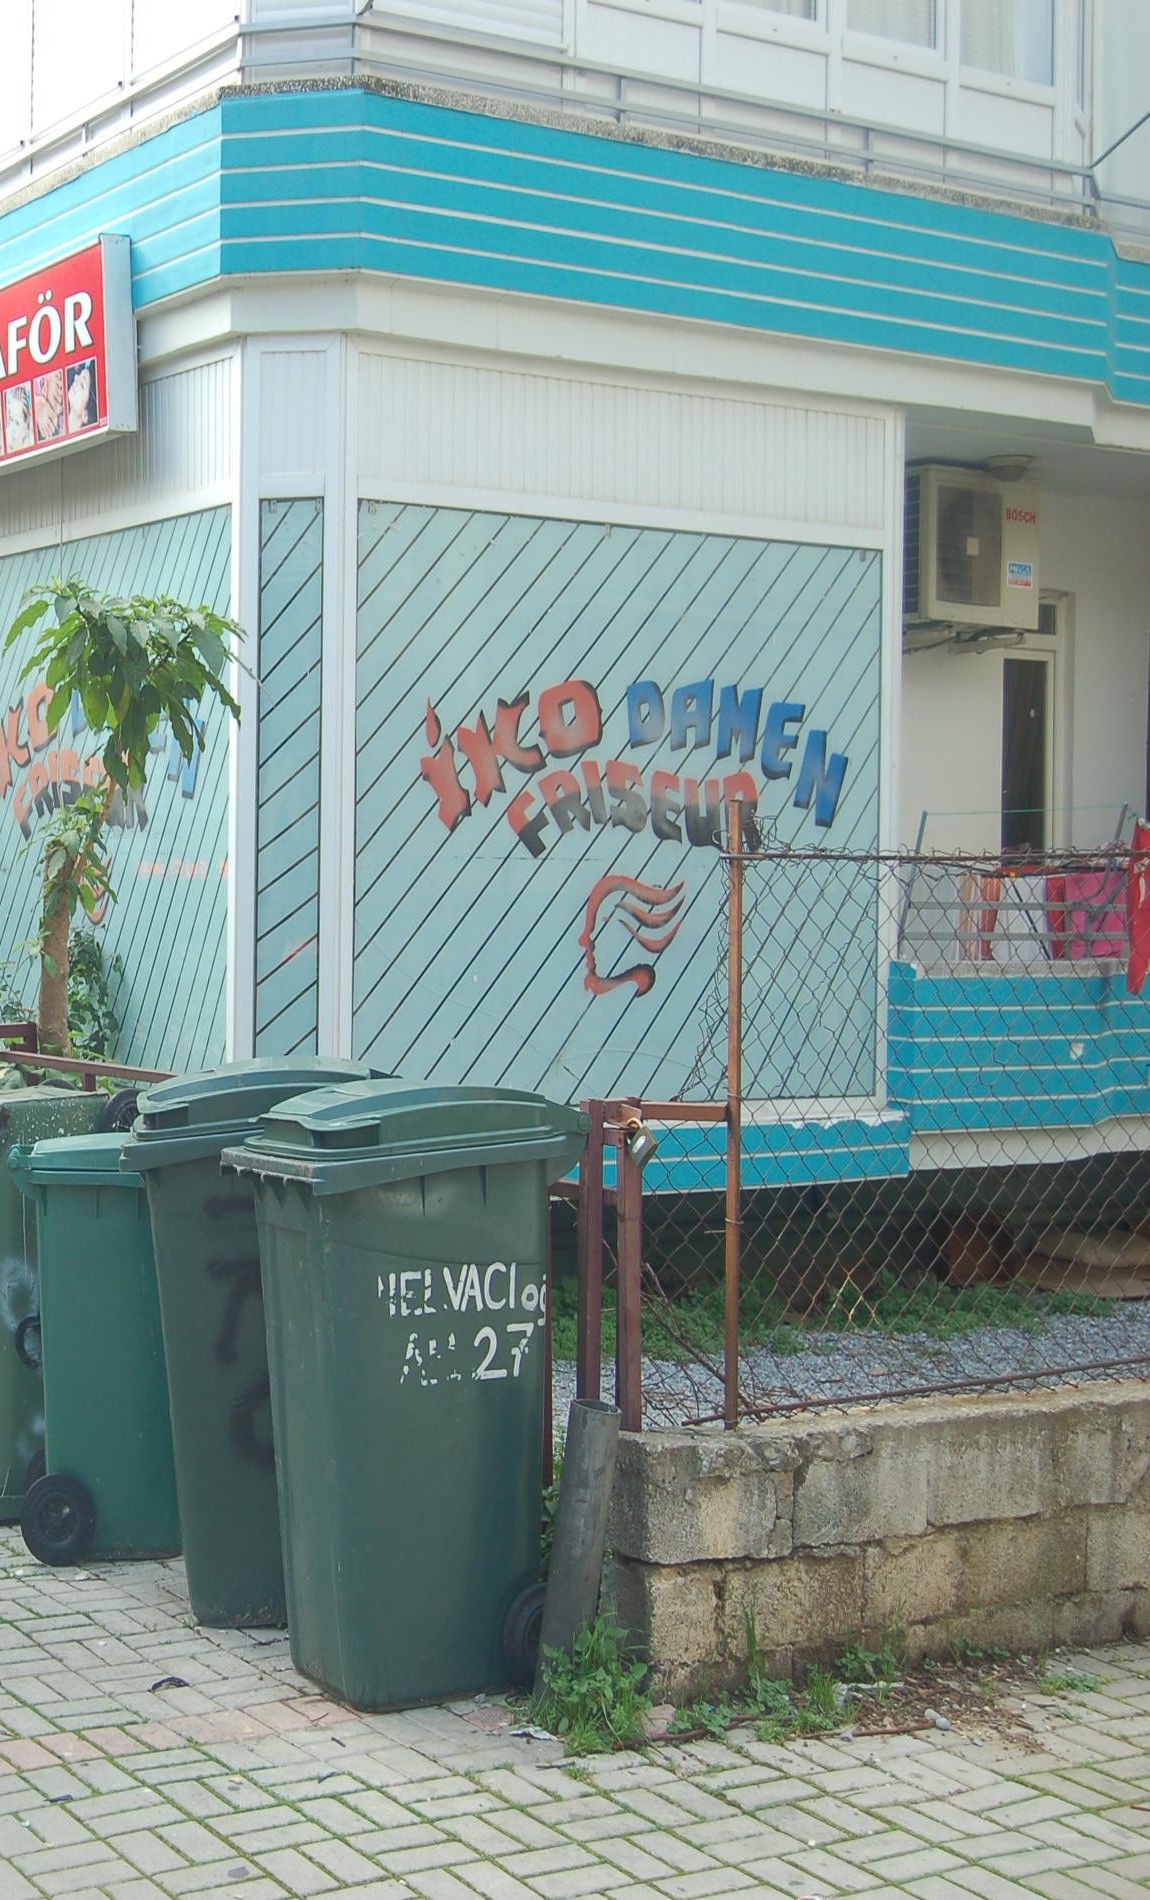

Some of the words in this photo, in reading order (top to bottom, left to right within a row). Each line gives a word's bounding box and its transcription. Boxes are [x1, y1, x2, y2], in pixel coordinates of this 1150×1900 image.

[1005, 507, 1036, 524] BOSCH
[626, 678, 849, 828] DAMEN
[507, 759, 763, 858] FRISEUR
[472, 1322, 534, 1380] 27
